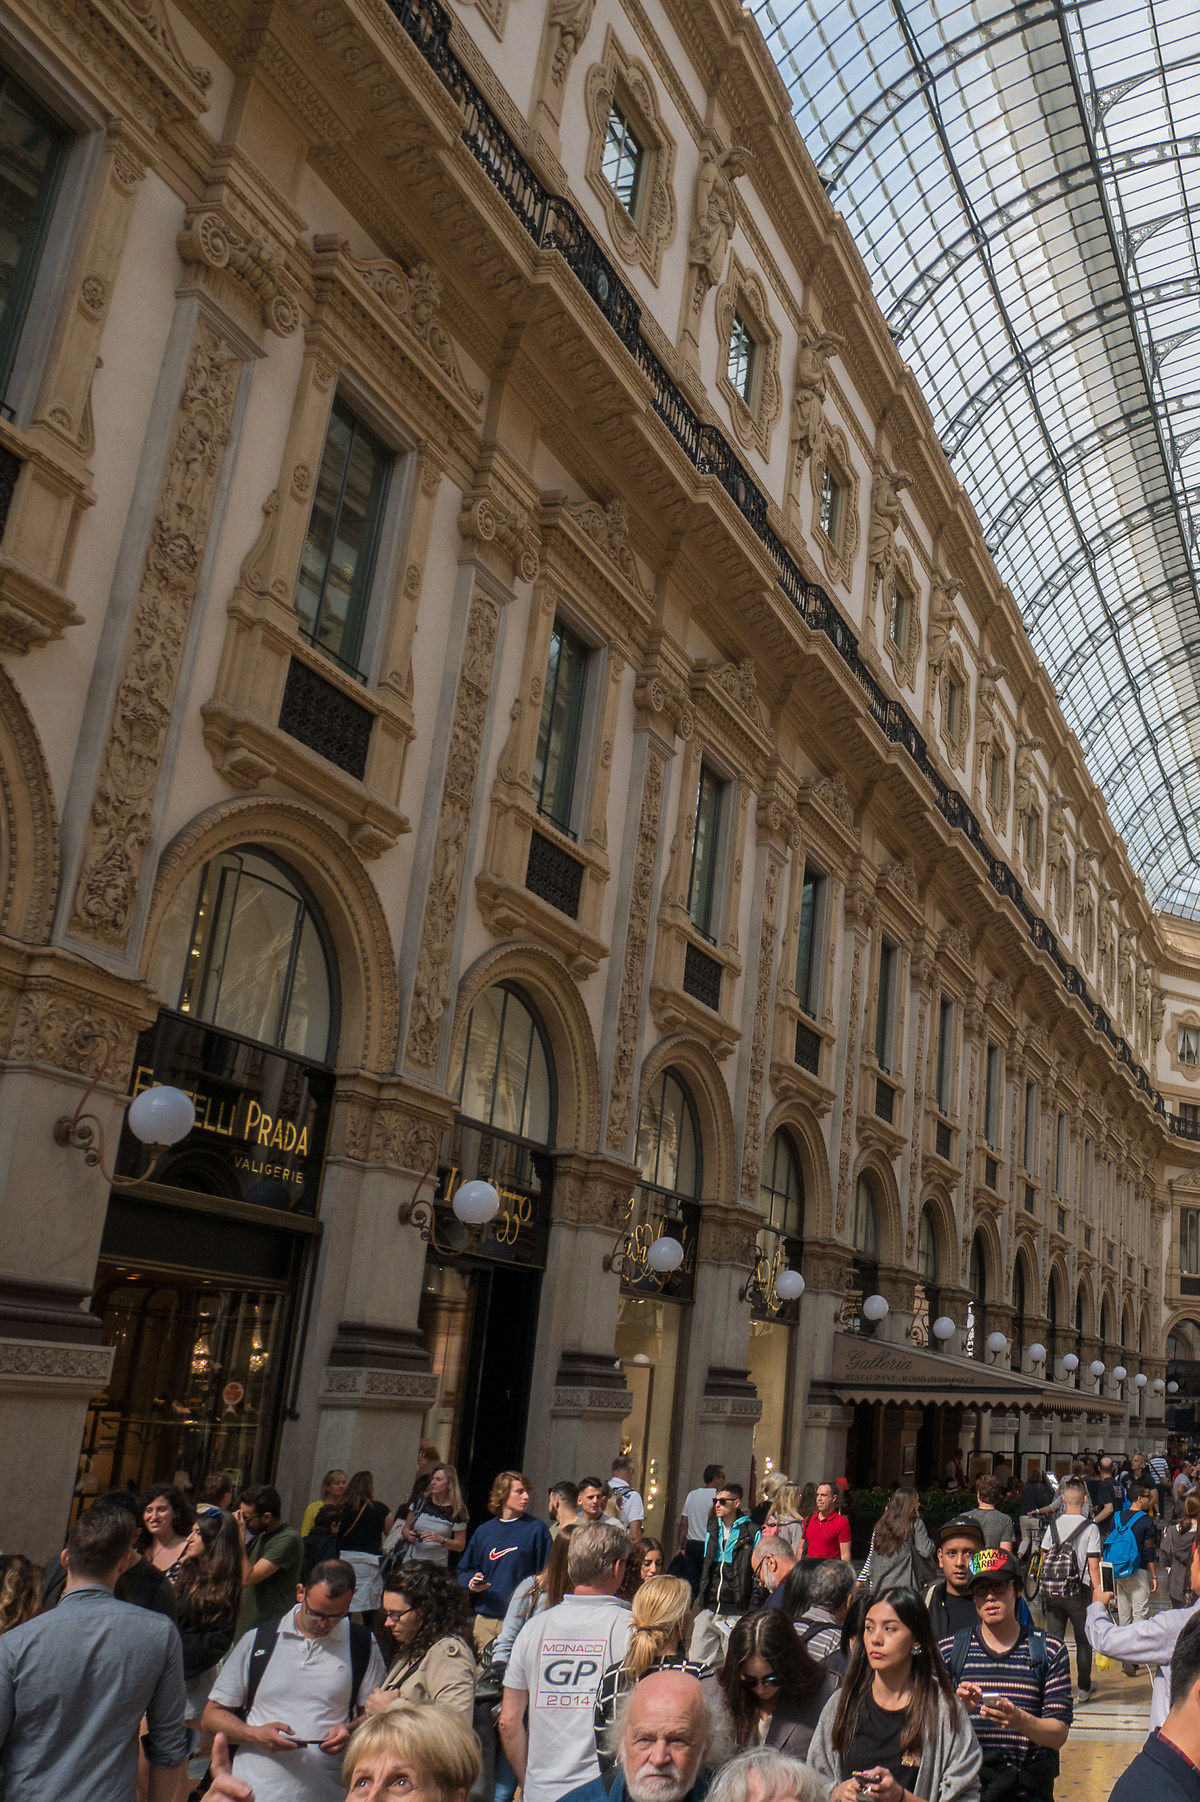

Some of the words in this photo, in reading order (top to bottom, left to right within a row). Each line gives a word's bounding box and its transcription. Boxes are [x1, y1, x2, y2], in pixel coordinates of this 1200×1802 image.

[133, 1066, 236, 1136] FELLI
[243, 1100, 308, 1157] PRADA
[234, 1155, 304, 1184] VALIGERIE
[845, 1350, 914, 1371] Galleria
[972, 1558, 998, 1573] FARBE
[542, 1644, 603, 1653] MONACO
[543, 1660, 598, 1686] GP
[546, 1695, 590, 1706] 2014
